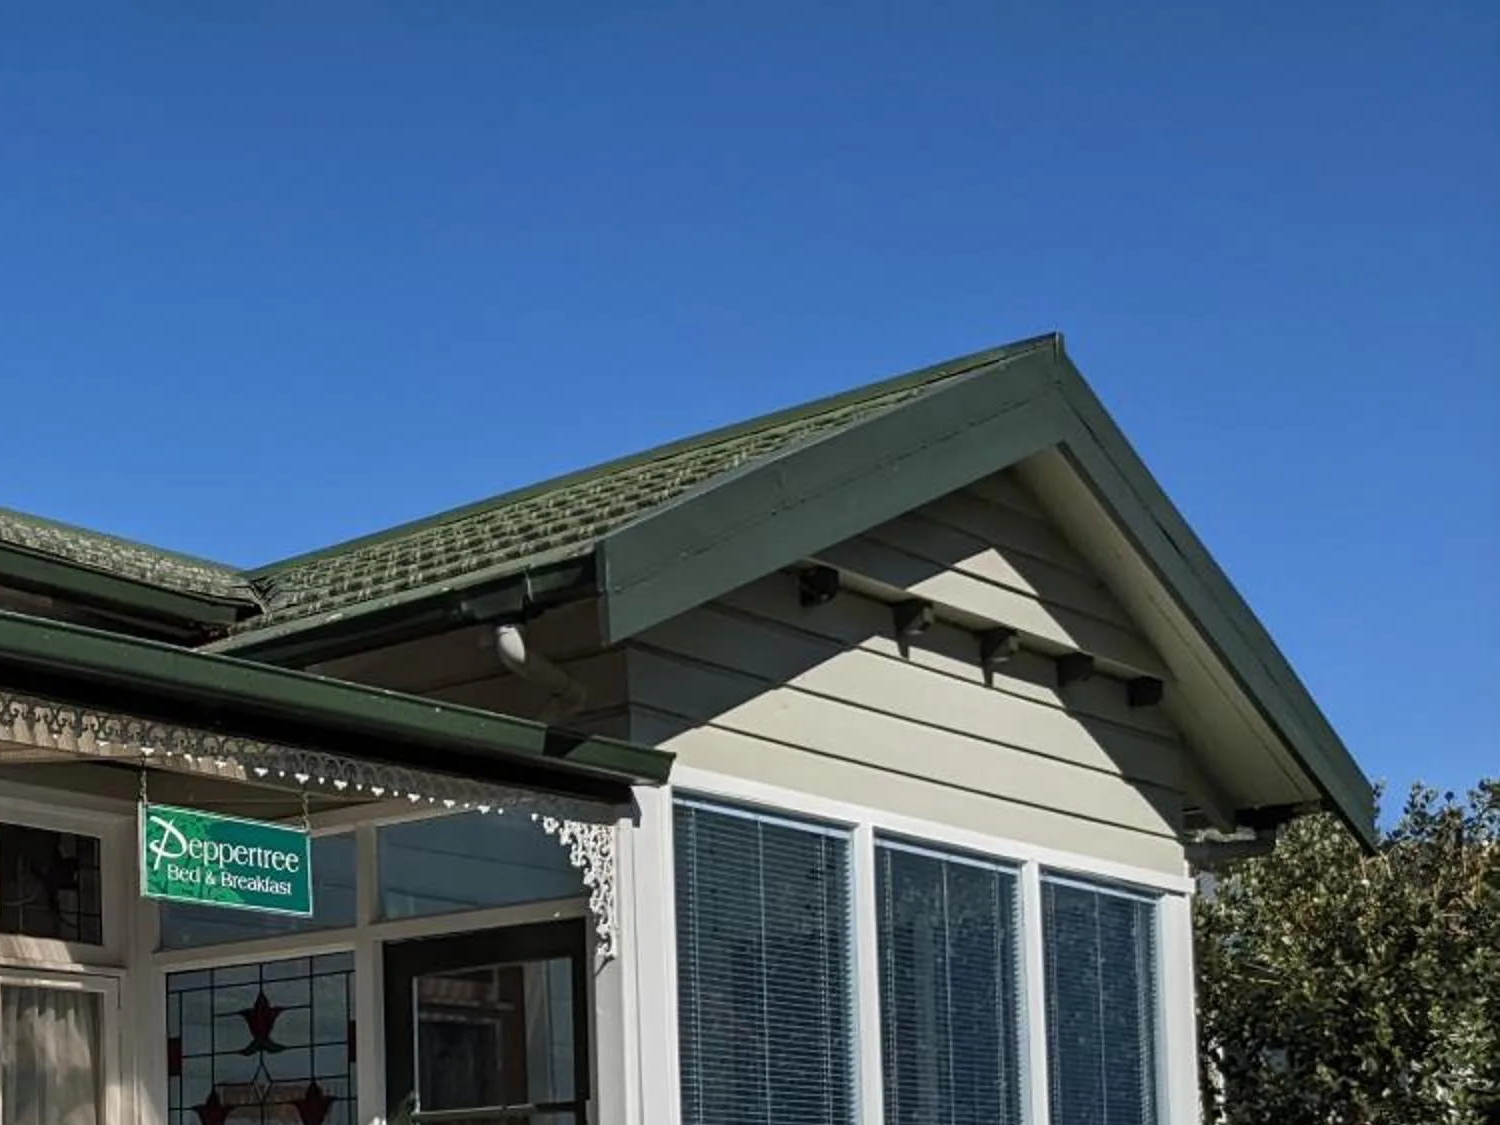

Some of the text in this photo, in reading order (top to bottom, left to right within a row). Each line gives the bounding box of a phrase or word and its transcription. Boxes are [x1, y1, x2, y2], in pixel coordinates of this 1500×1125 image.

[149, 815, 299, 873] Peppertree
[167, 863, 292, 895] Bed & Breakfast
